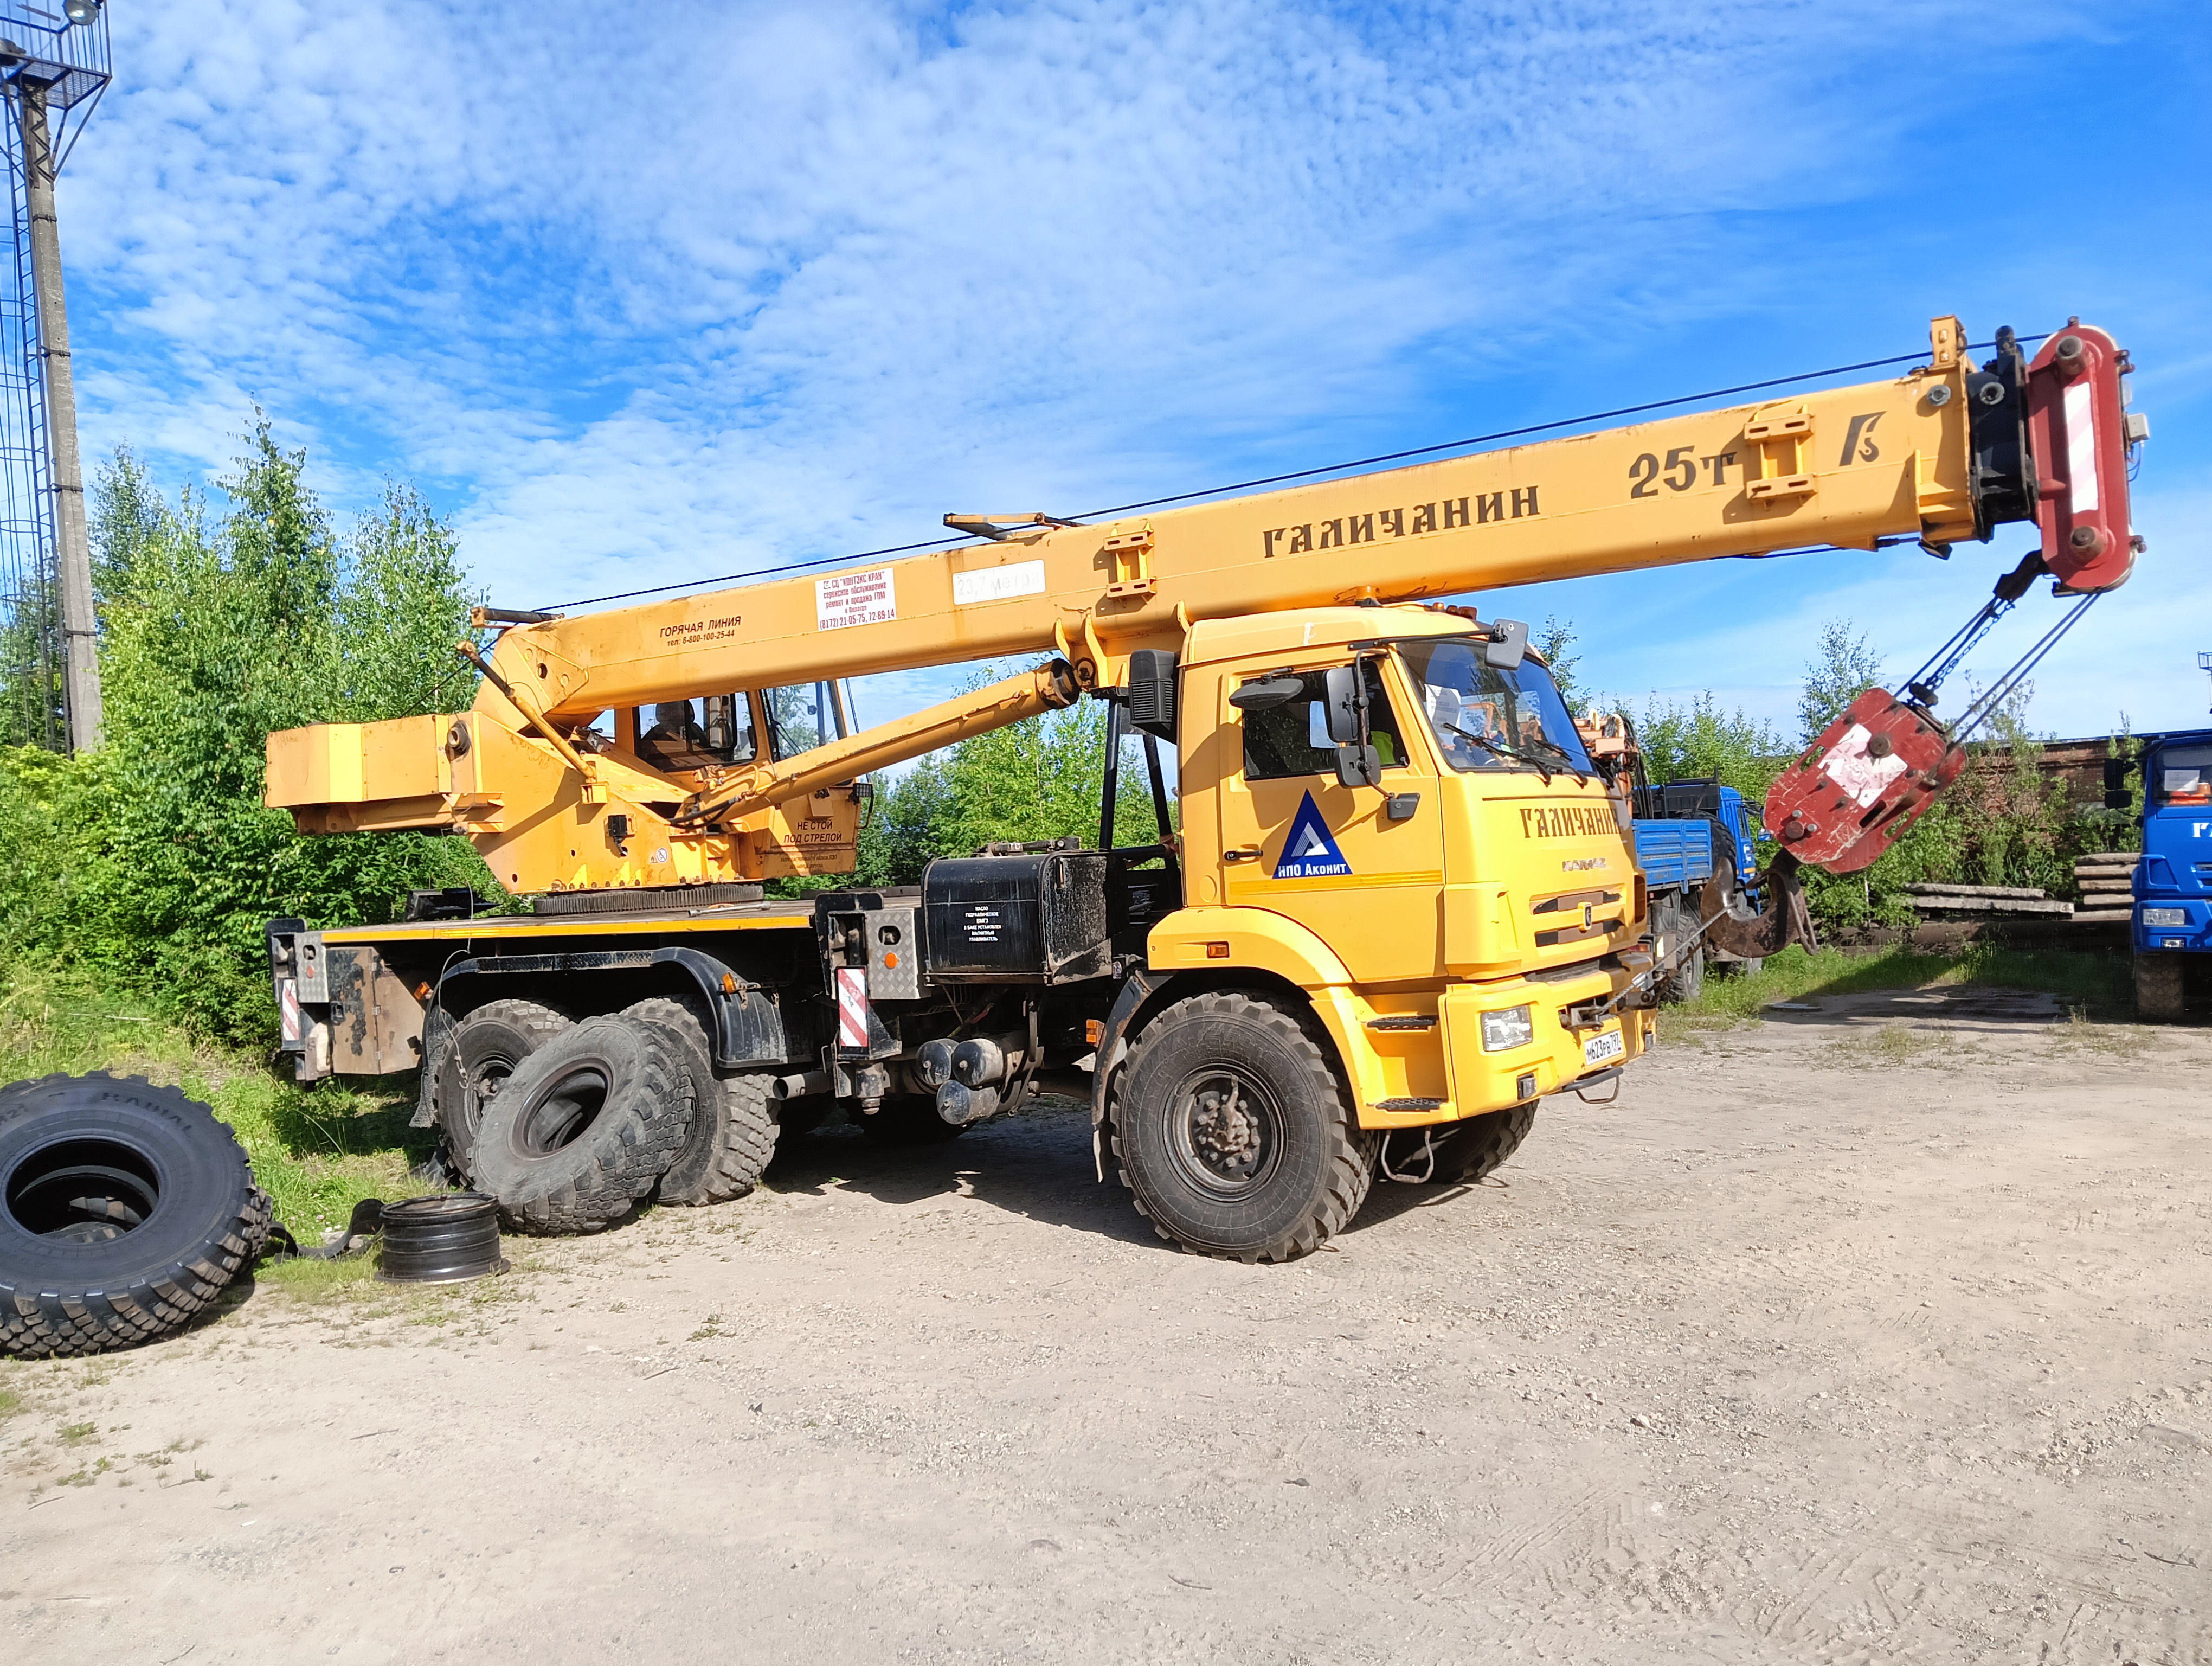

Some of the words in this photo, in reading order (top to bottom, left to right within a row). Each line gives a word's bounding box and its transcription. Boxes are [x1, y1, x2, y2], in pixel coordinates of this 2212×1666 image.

[1263, 485, 1539, 559] ГАЛИЧАНИН
[824, 589, 849, 599] сервисное
[851, 582, 886, 594] обслуживание
[958, 576, 986, 597] 23,7
[826, 599, 844, 610] ремонт
[851, 594, 872, 605] продажа
[874, 591, 885, 600] ГПМ
[660, 621, 703, 638] ГОРЯЧАЯ
[708, 616, 741, 630] ЛИНИЯ
[820, 618, 839, 630] (8172)
[840, 613, 867, 626] 21-05-75,
[868, 608, 895, 621] 72-89-14
[683, 629, 735, 644] 8-800-100-25-44
[797, 822, 808, 830] НЕ
[810, 819, 832, 830] СТОЙ
[1519, 808, 1622, 838] ГАЛИЧАНИН
[784, 834, 802, 843] ПОД
[804, 831, 842, 842] СТРЕЛОЙ
[1278, 864, 1301, 877] НПО
[1562, 857, 1606, 872] KAMAZ
[1610, 1033, 1619, 1048] 797
